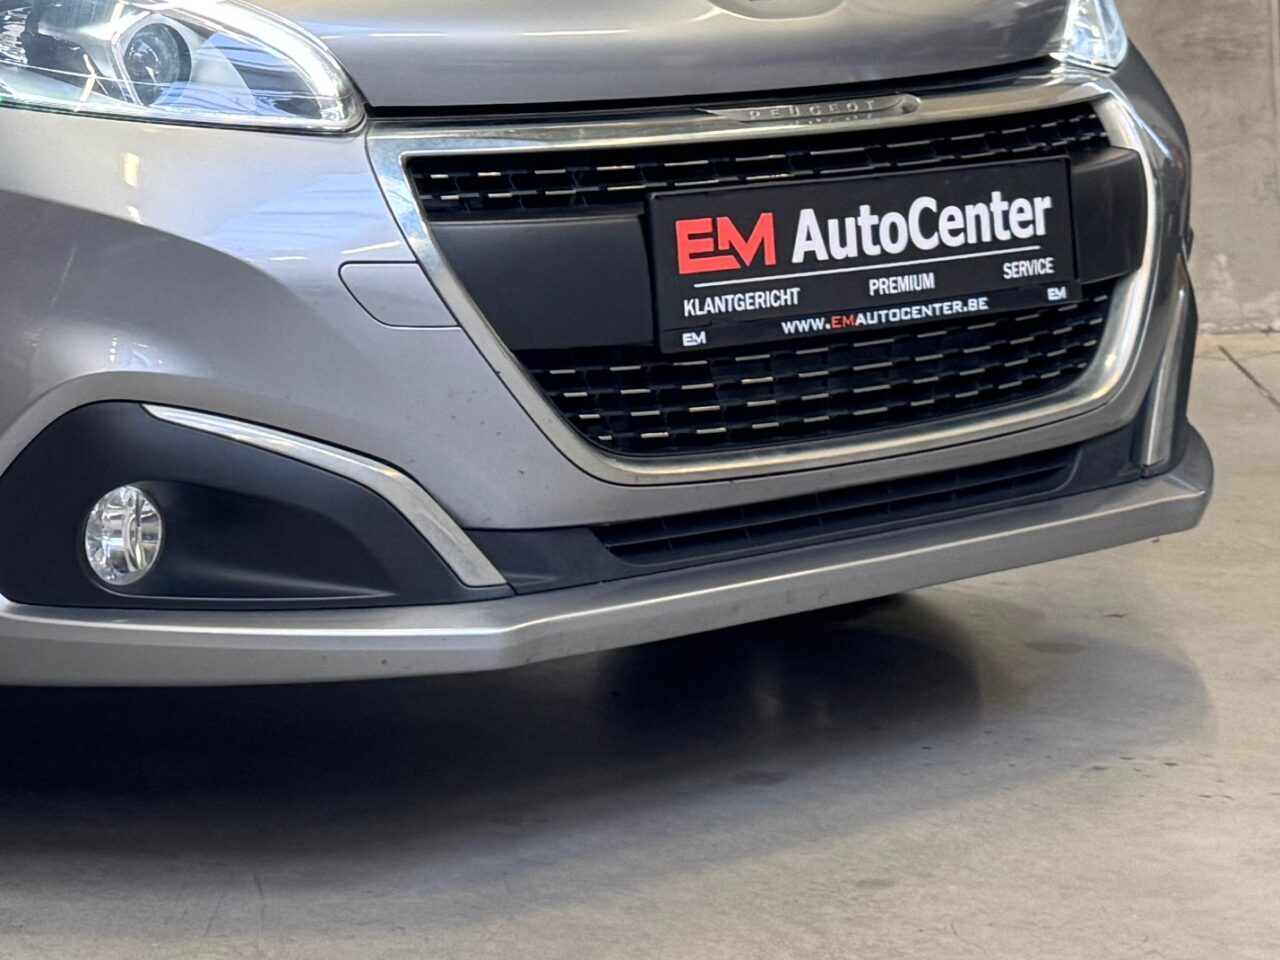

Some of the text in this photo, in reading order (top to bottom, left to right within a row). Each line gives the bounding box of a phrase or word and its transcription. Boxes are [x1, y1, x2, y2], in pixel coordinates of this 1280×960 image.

[748, 99, 876, 120] PEUGEOT
[675, 191, 1053, 274] EM AutoCenter
[1003, 257, 1054, 280] SERVICE
[869, 273, 935, 296] PREMIUM
[1047, 286, 1067, 301] EM
[683, 288, 800, 317] KLANTGERICHT
[781, 297, 989, 334] WWW.EMAUTOCENTER.BE
[682, 331, 707, 347] EM
